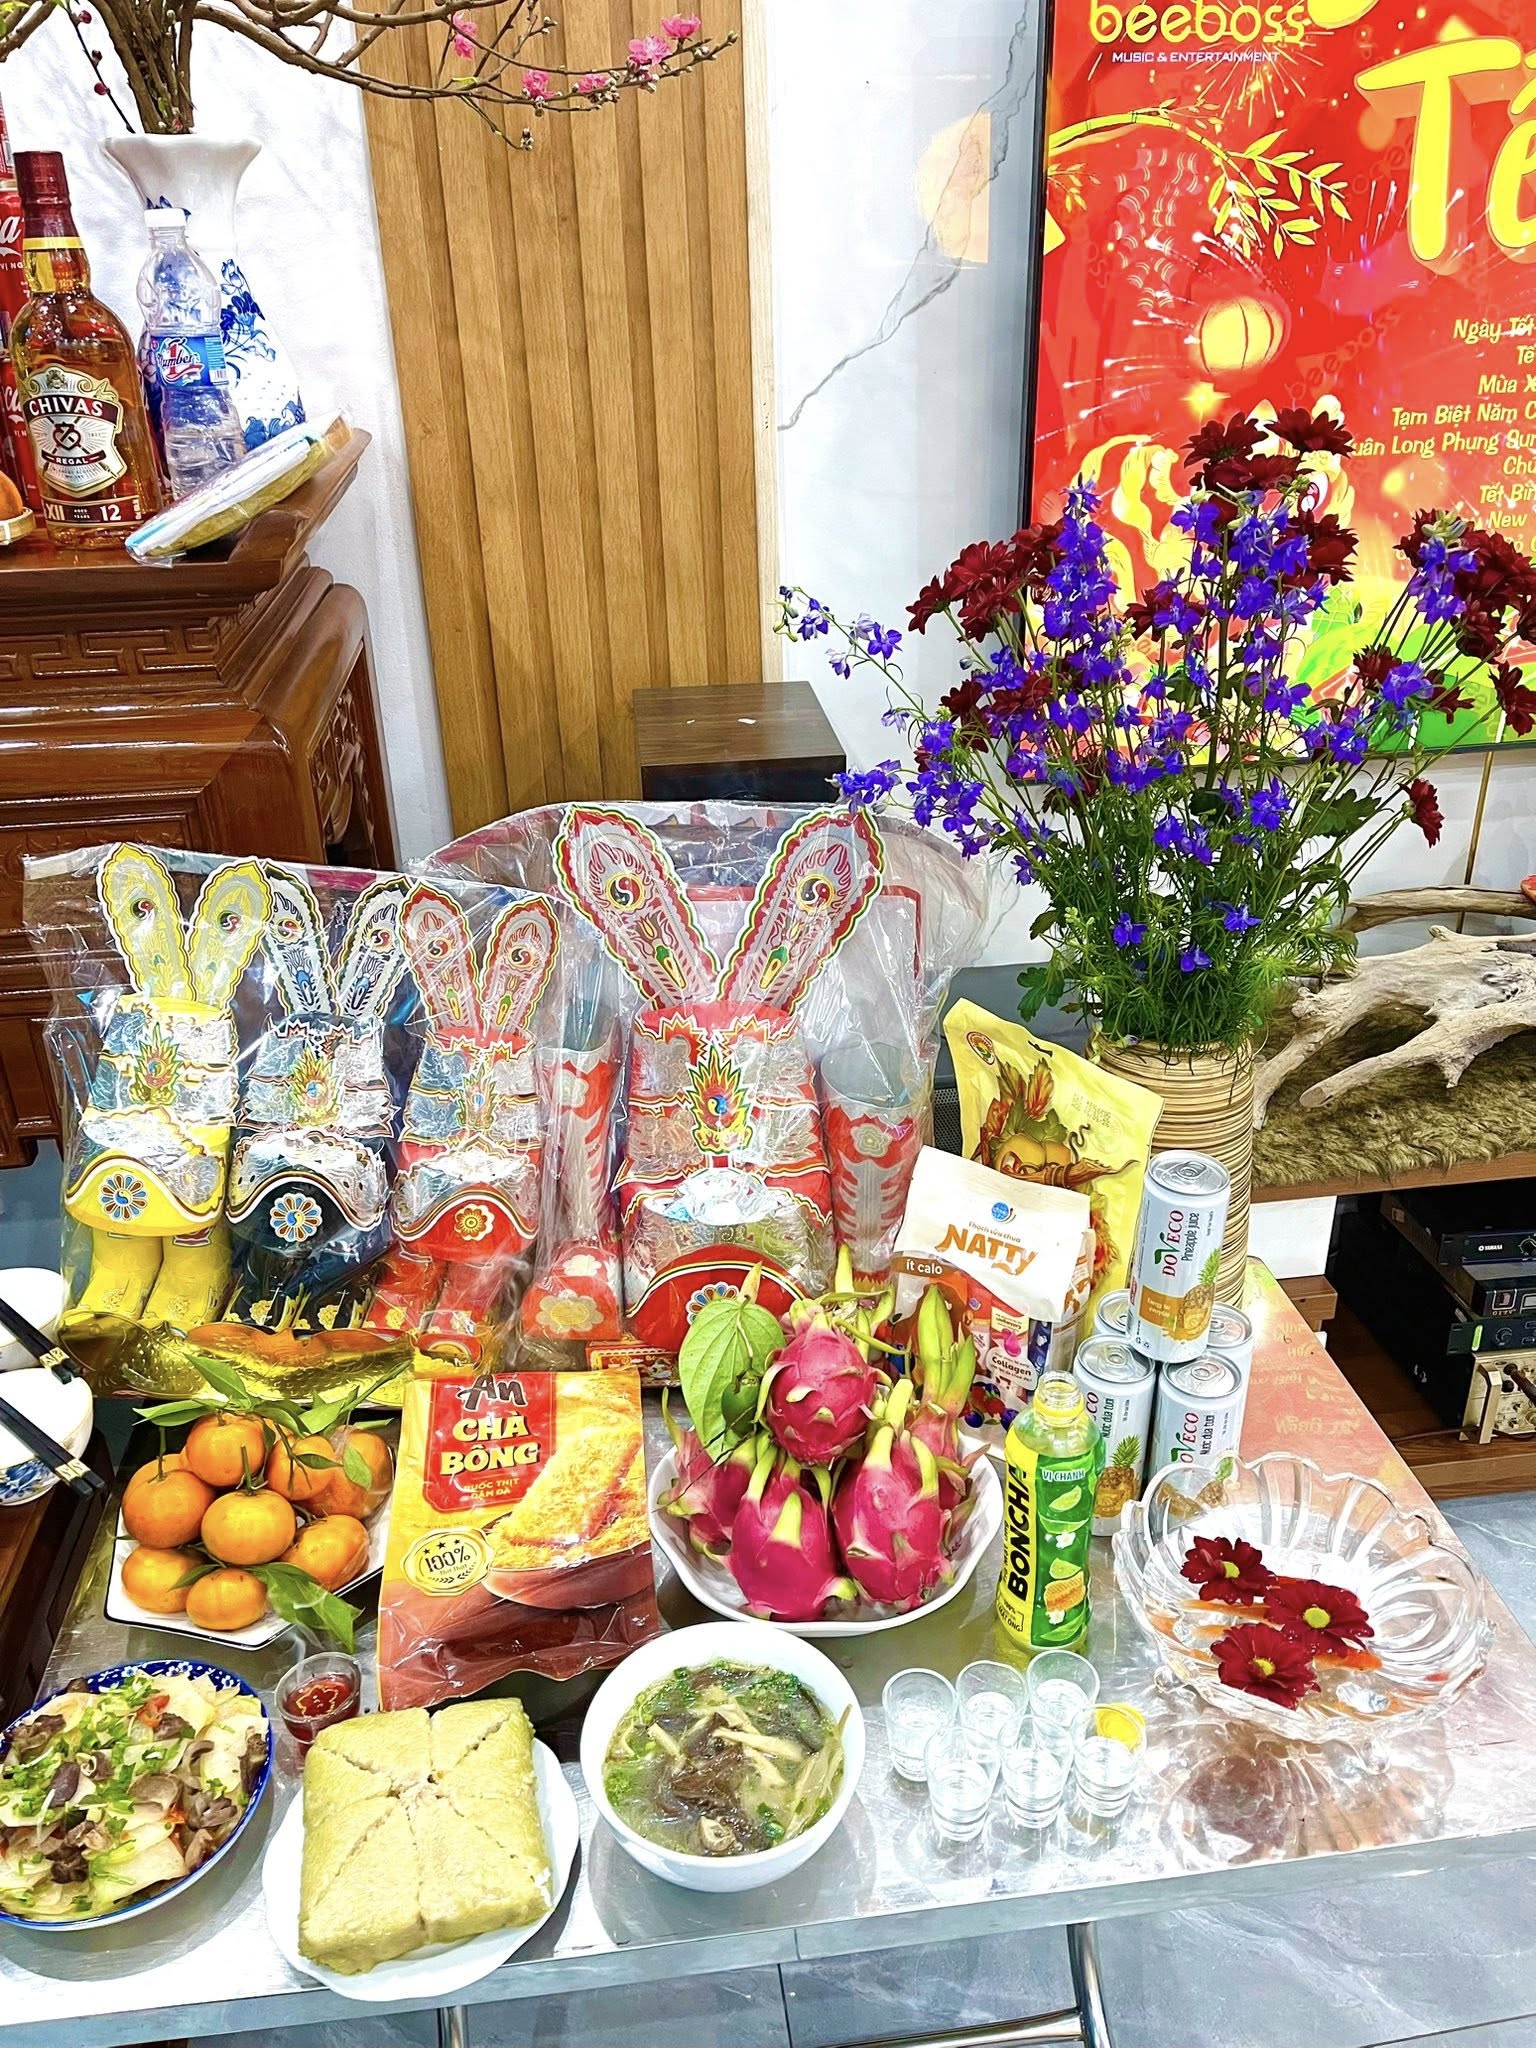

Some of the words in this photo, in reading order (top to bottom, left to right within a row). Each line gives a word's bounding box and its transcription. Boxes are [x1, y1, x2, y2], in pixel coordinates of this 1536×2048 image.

[1090, 0, 1305, 43] beeboss
[1112, 51, 1155, 63] MUSIC
[1157, 51, 1167, 63] &
[1170, 51, 1280, 63] ENTERTAINMENT
[1453, 318, 1502, 344] Ngày
[1478, 374, 1517, 395] Mùa
[29, 397, 103, 416] CHIVAS
[1392, 407, 1428, 430] Tạm
[1434, 404, 1471, 427] Biệt
[1476, 402, 1517, 423] Năm
[1391, 435, 1436, 459] Long
[1442, 431, 1499, 456] Phụng
[55, 456, 89, 465] REGAL
[1480, 482, 1505, 504] Tết
[100, 504, 121, 521] 12
[1488, 510, 1527, 530] New
[1188, 1212, 1200, 1230] juice
[934, 1224, 1038, 1276] NATTY
[1154, 1209, 1184, 1277] DOVECO
[1181, 1229, 1198, 1262] Pineapple
[906, 1259, 915, 1271] ít
[917, 1263, 943, 1274] calo
[992, 1356, 1032, 1376] Collagen
[452, 1411, 531, 1442] CHÀ
[1171, 1412, 1199, 1464] OVECO
[440, 1442, 541, 1476] BÔNG
[1053, 1469, 1085, 1481] CHANH
[425, 1545, 471, 1573] 100%
